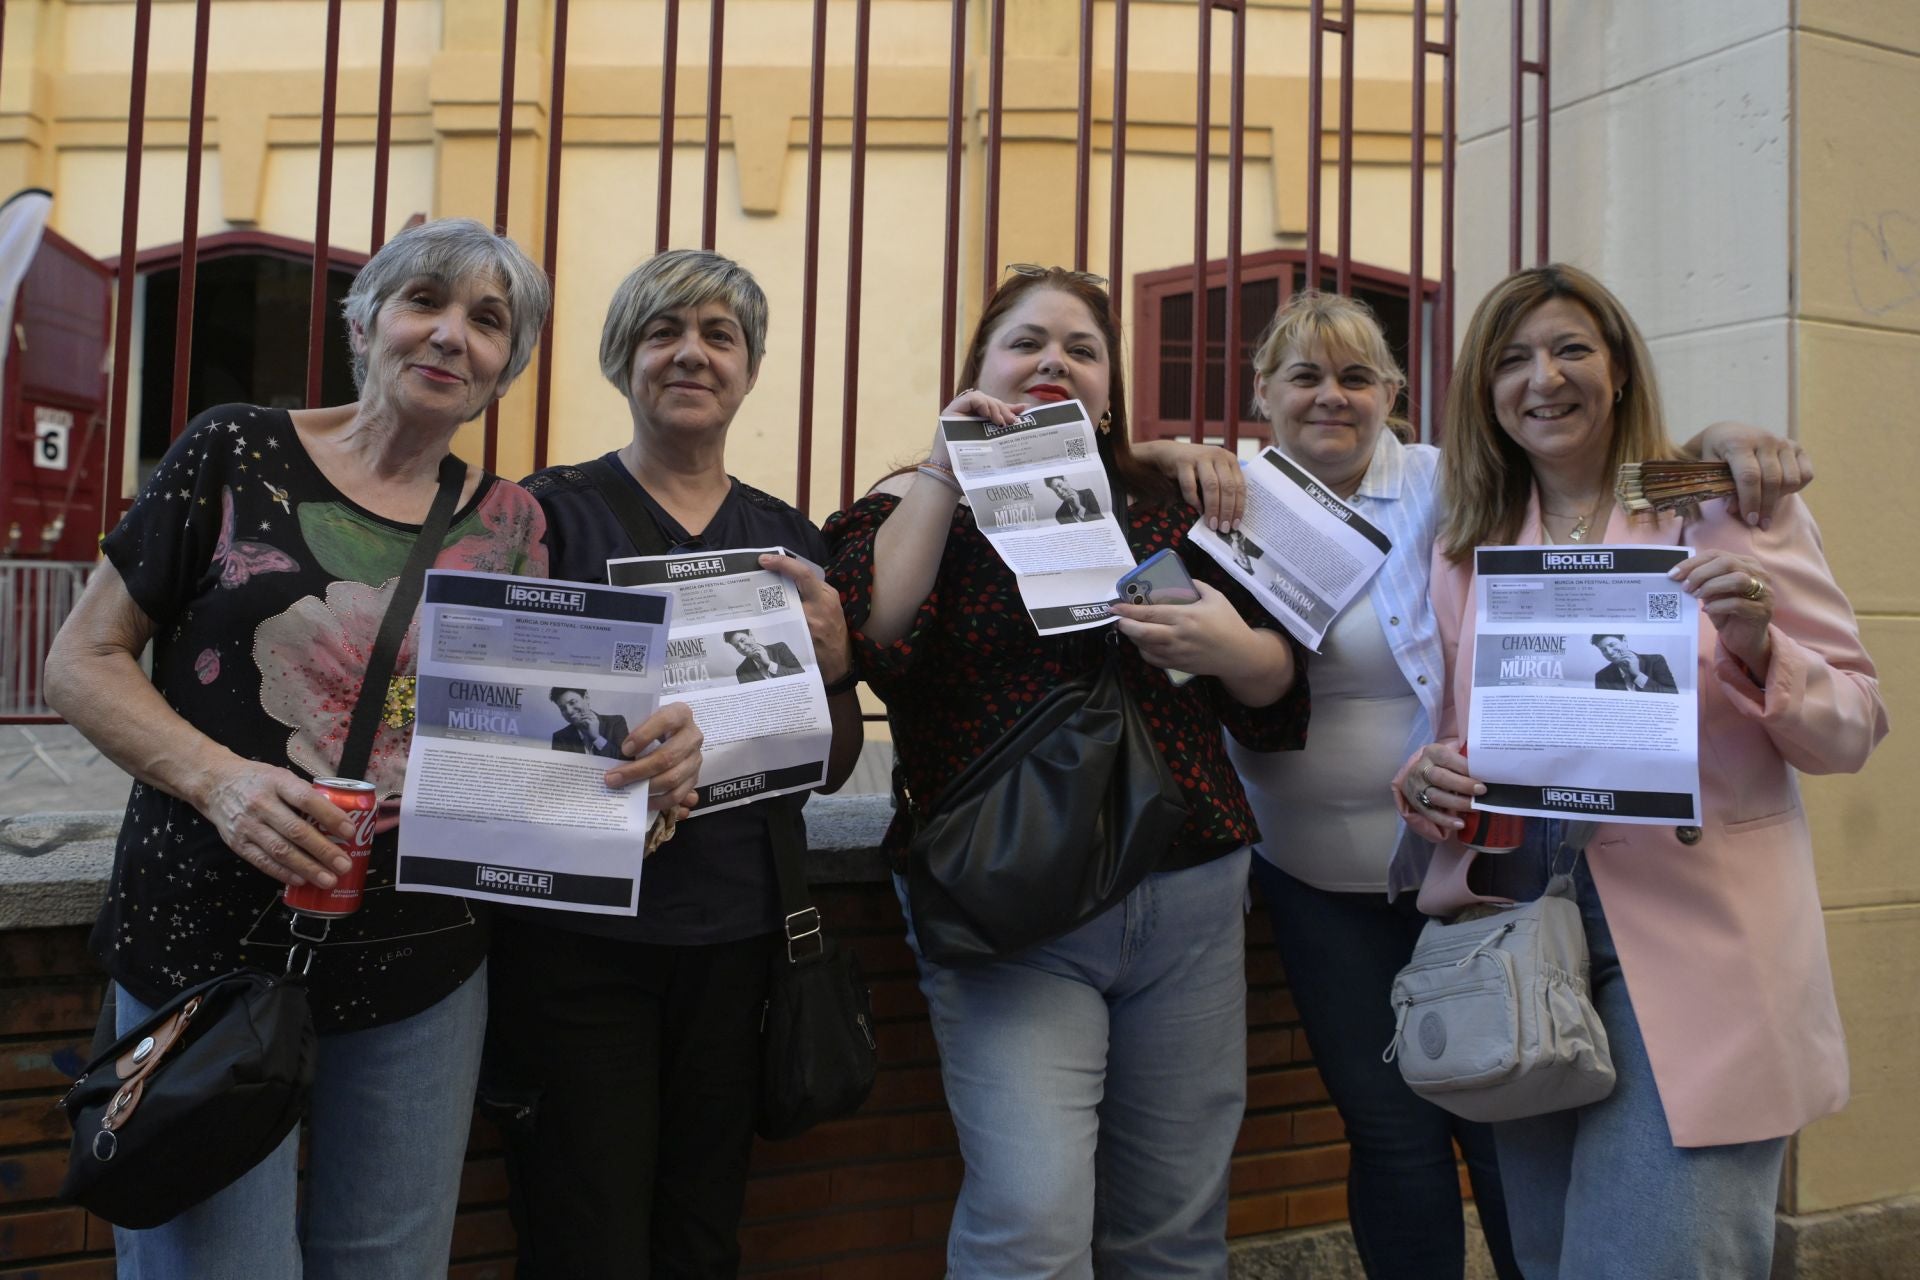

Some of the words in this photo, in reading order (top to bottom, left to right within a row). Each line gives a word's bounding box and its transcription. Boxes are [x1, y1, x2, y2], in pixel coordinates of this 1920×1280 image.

[43, 431, 58, 460] 6
[986, 482, 1033, 501] CHAYANNE
[994, 506, 1037, 527] MURCIA
[1275, 573, 1315, 612] MURCIA
[1502, 635, 1567, 650] CHAYANNE
[1500, 660, 1564, 679] MURCIA
[448, 681, 523, 706] CHAYANNE
[448, 711, 520, 736] MURCIA
